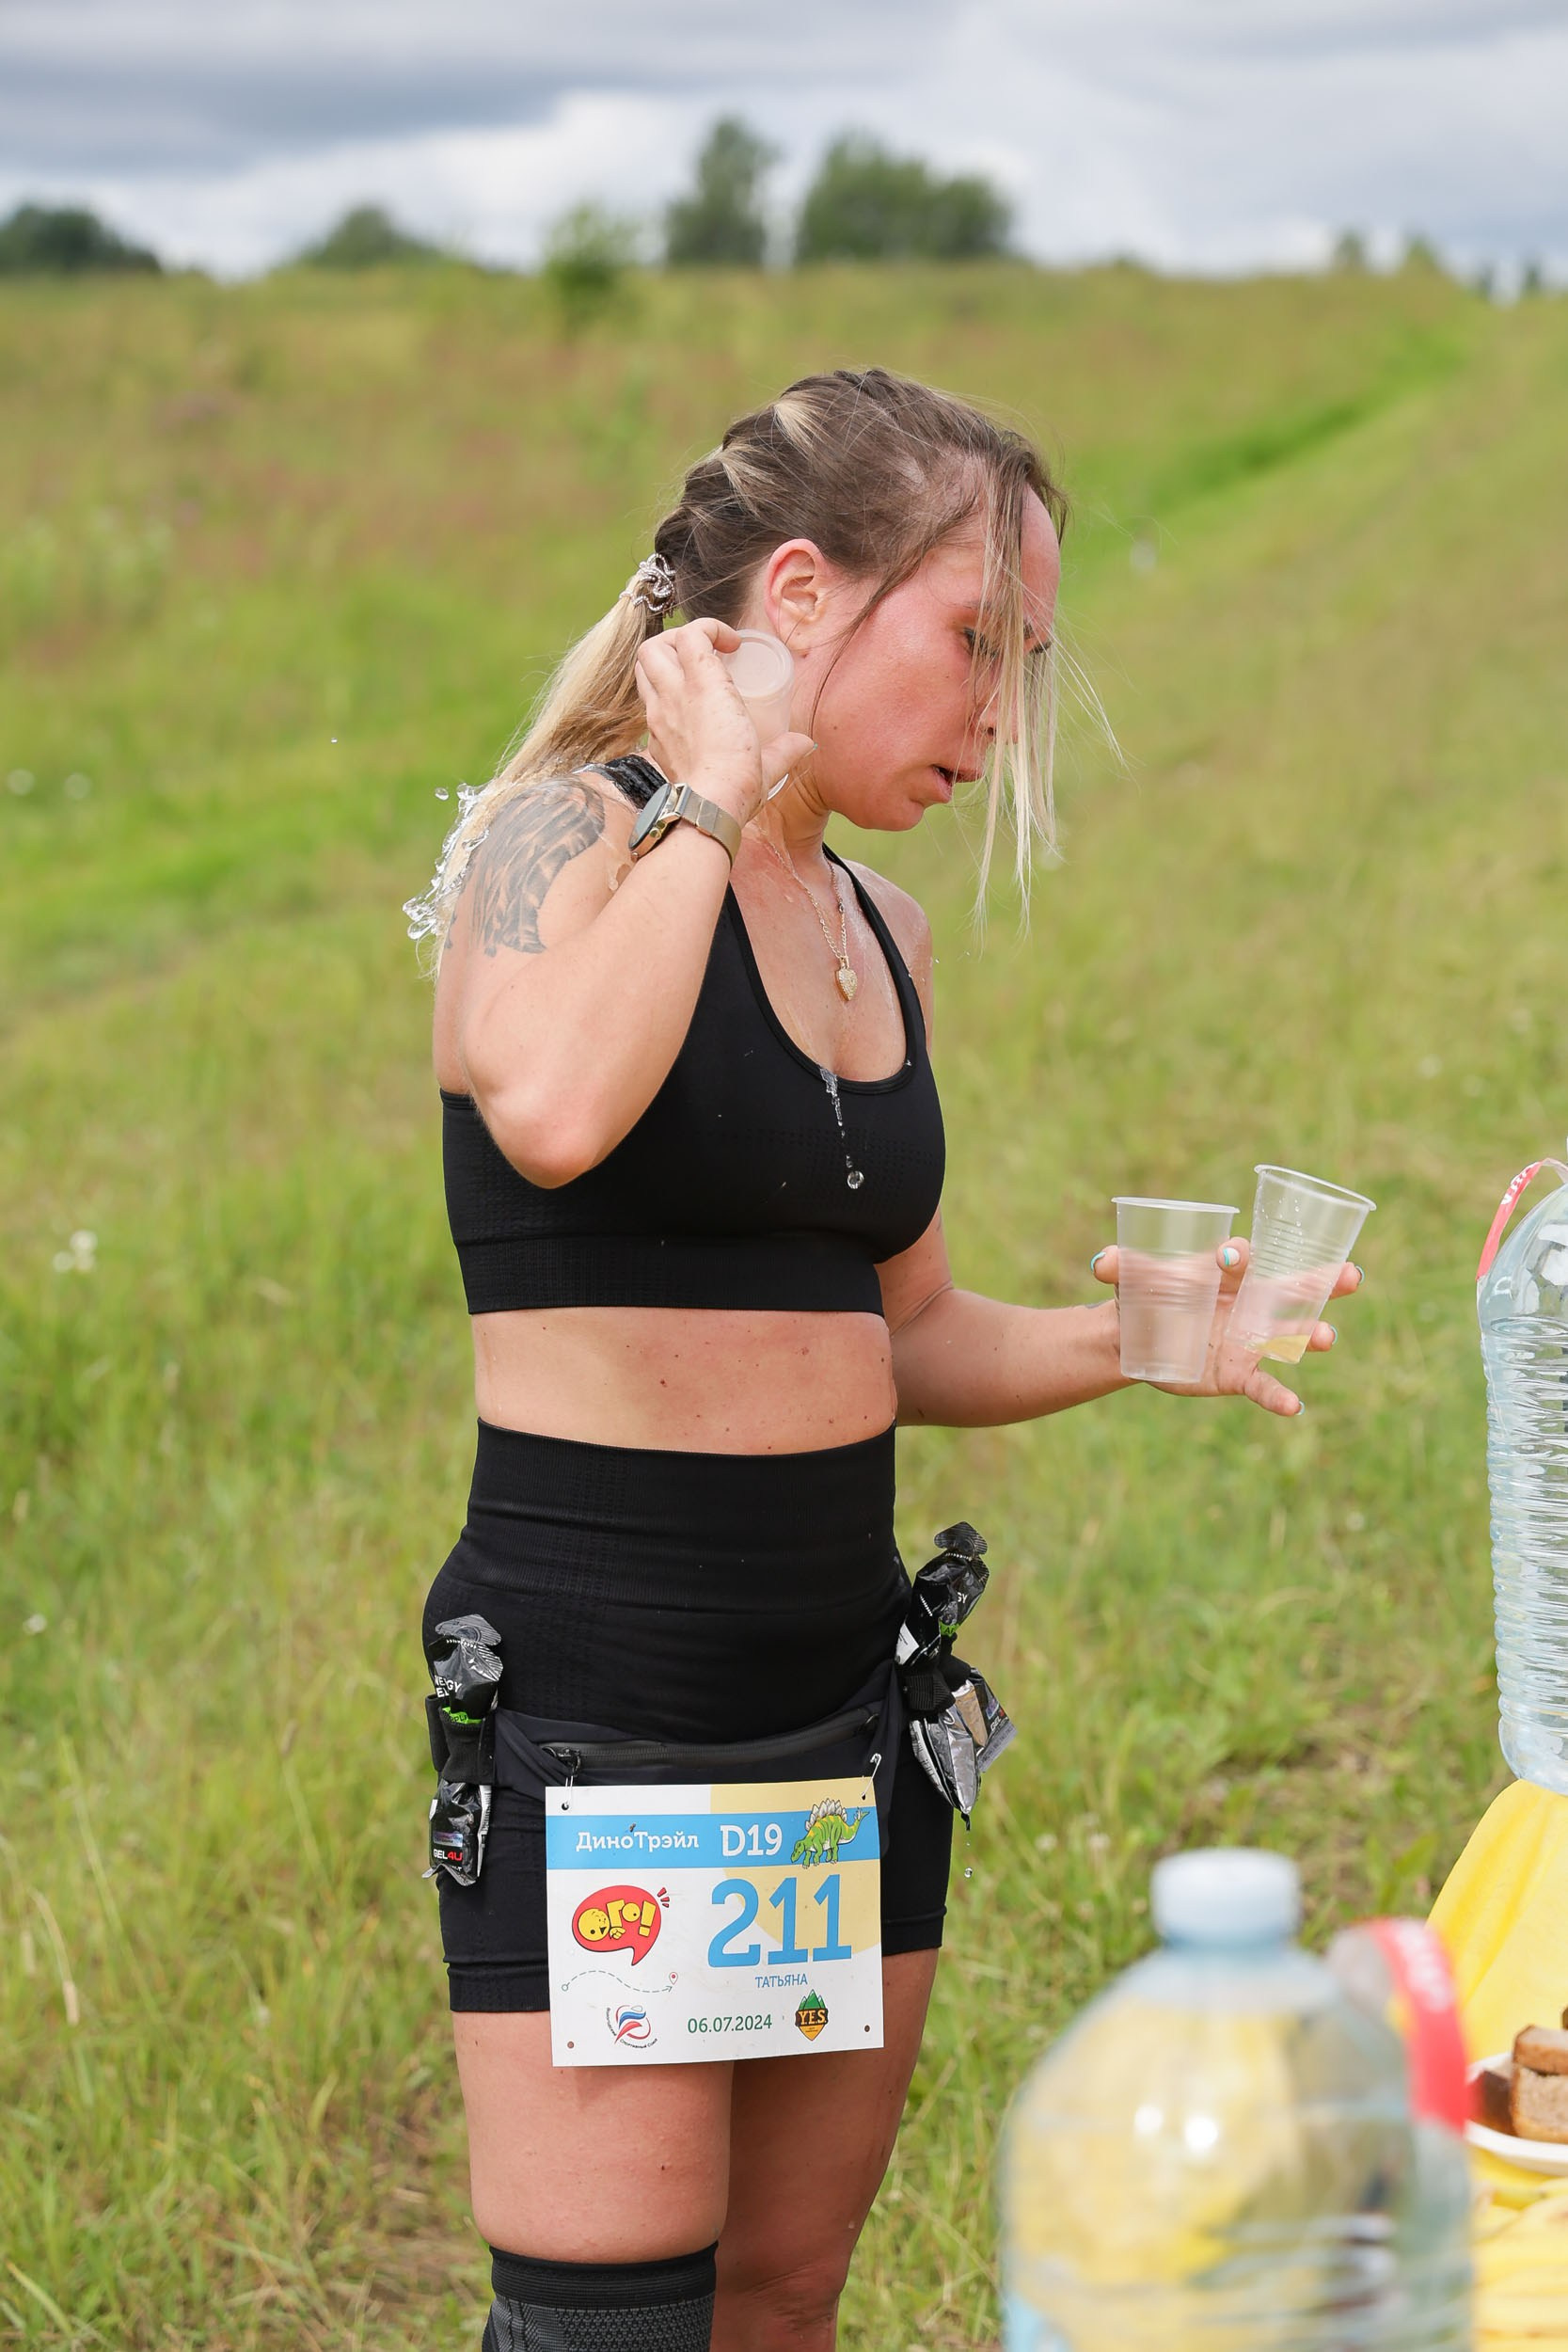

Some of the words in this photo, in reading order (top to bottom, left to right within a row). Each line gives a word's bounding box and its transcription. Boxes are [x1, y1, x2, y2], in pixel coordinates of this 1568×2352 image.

[576, 1831, 699, 1852] ДиноТрэйл
[720, 1823, 783, 1857] D19
[433, 1848, 464, 1862] GEL4U
[578, 1899, 657, 1942] ОГО!
[707, 1873, 852, 1968] 211
[755, 1973, 808, 1989] ТАТЬЯНА
[687, 2013, 773, 2034] 06.07.2024
